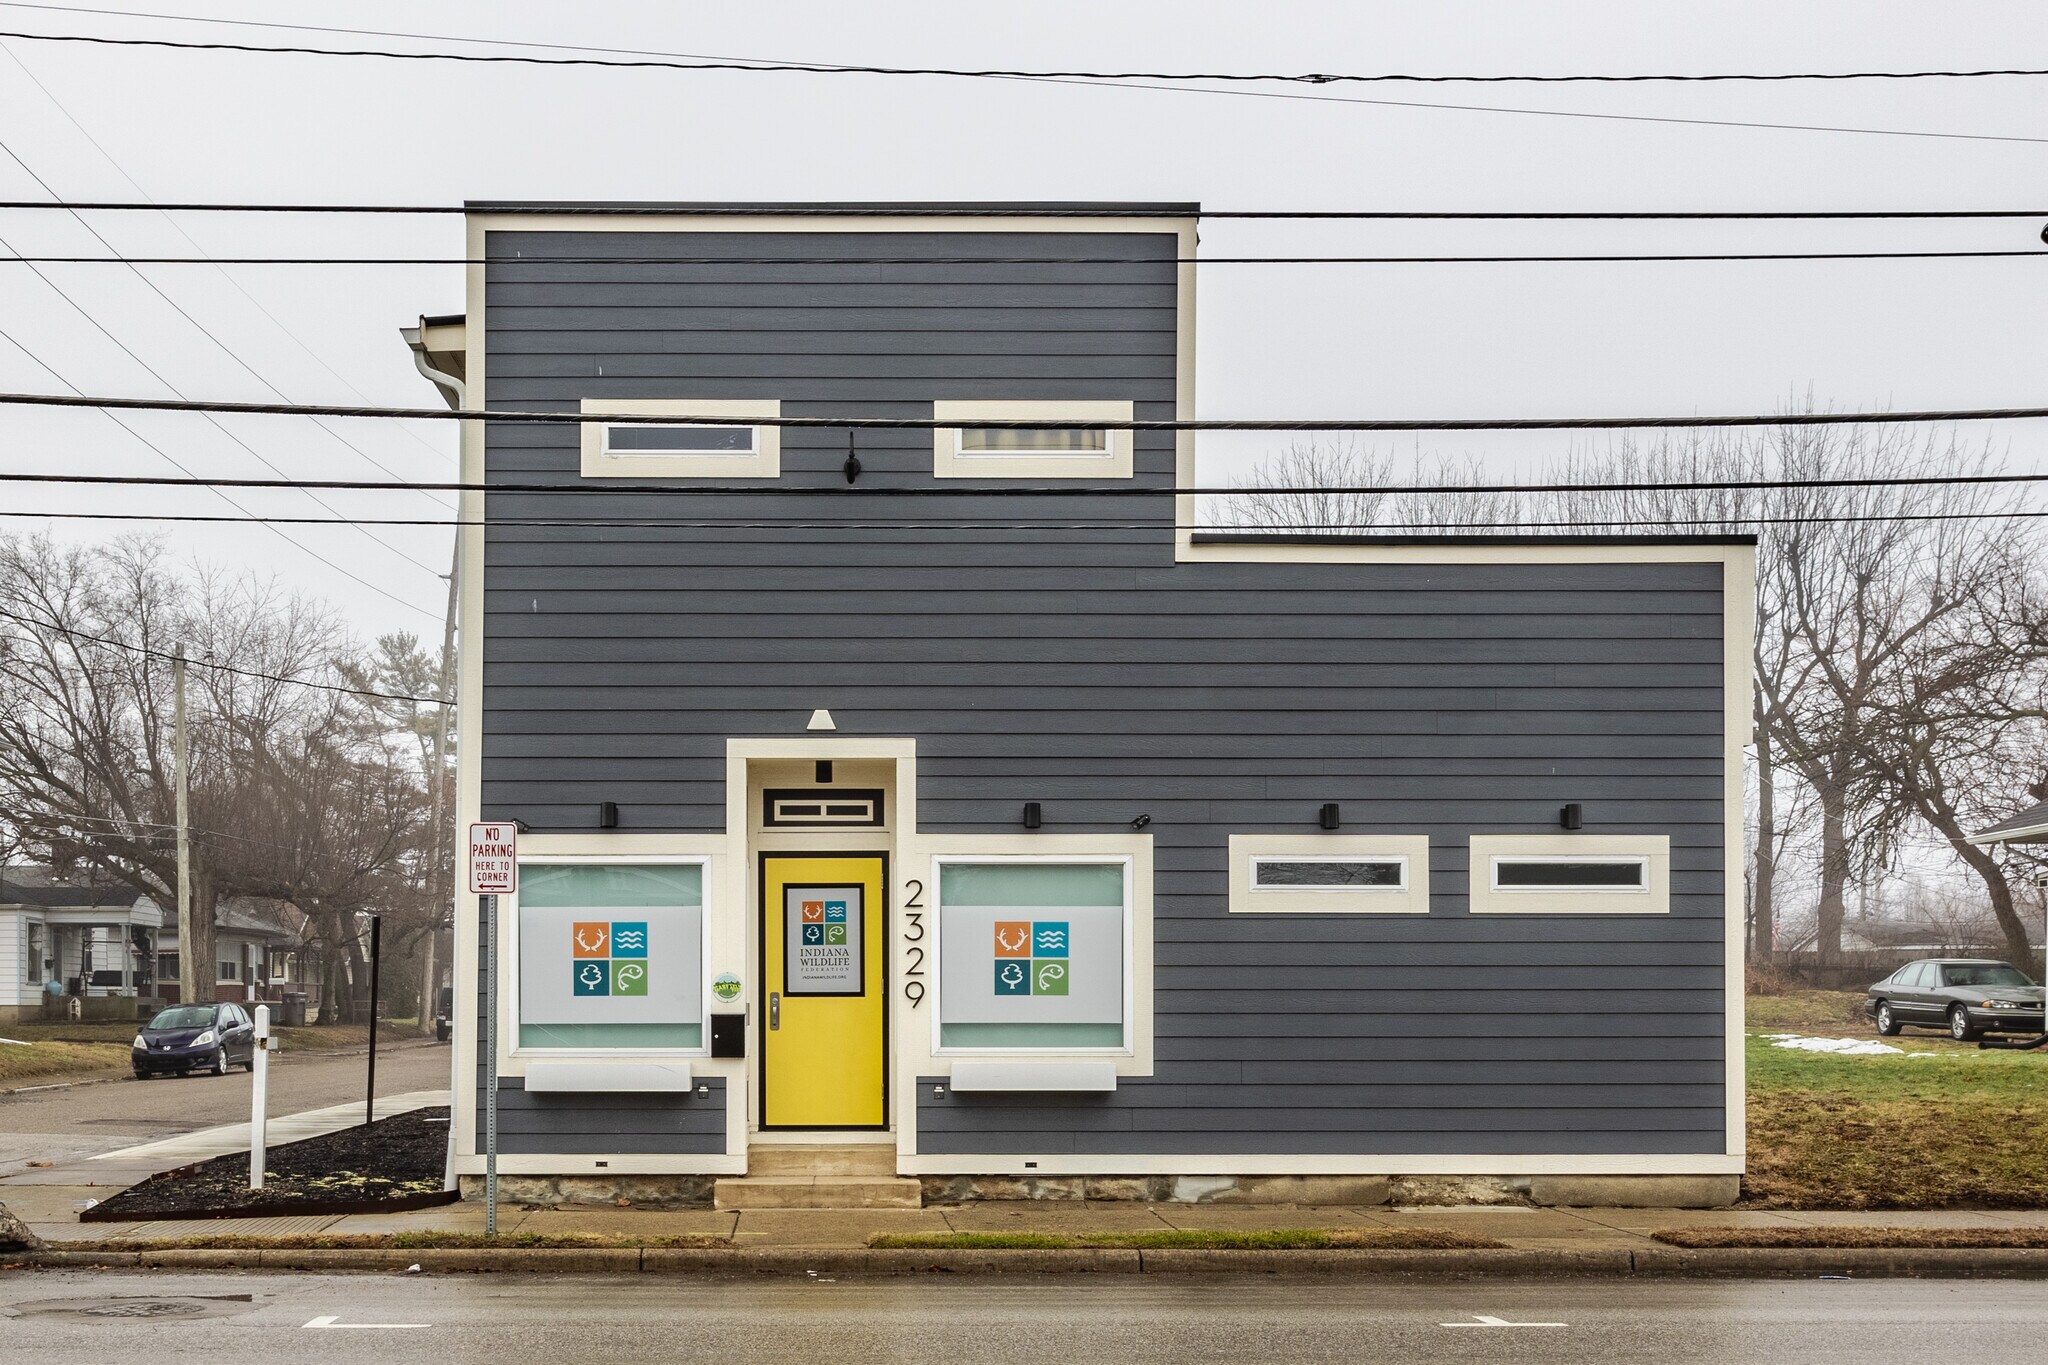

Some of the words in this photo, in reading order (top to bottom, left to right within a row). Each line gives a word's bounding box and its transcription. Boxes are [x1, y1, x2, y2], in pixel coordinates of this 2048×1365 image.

[485, 827, 500, 841] NO
[472, 844, 513, 857] PARKING
[475, 861, 495, 871] HERE
[500, 861, 510, 871] TO
[476, 872, 508, 882] CORNER
[903, 879, 925, 1009] 2329
[800, 948, 850, 957] INDIANA
[800, 957, 850, 967] WILDLIFE
